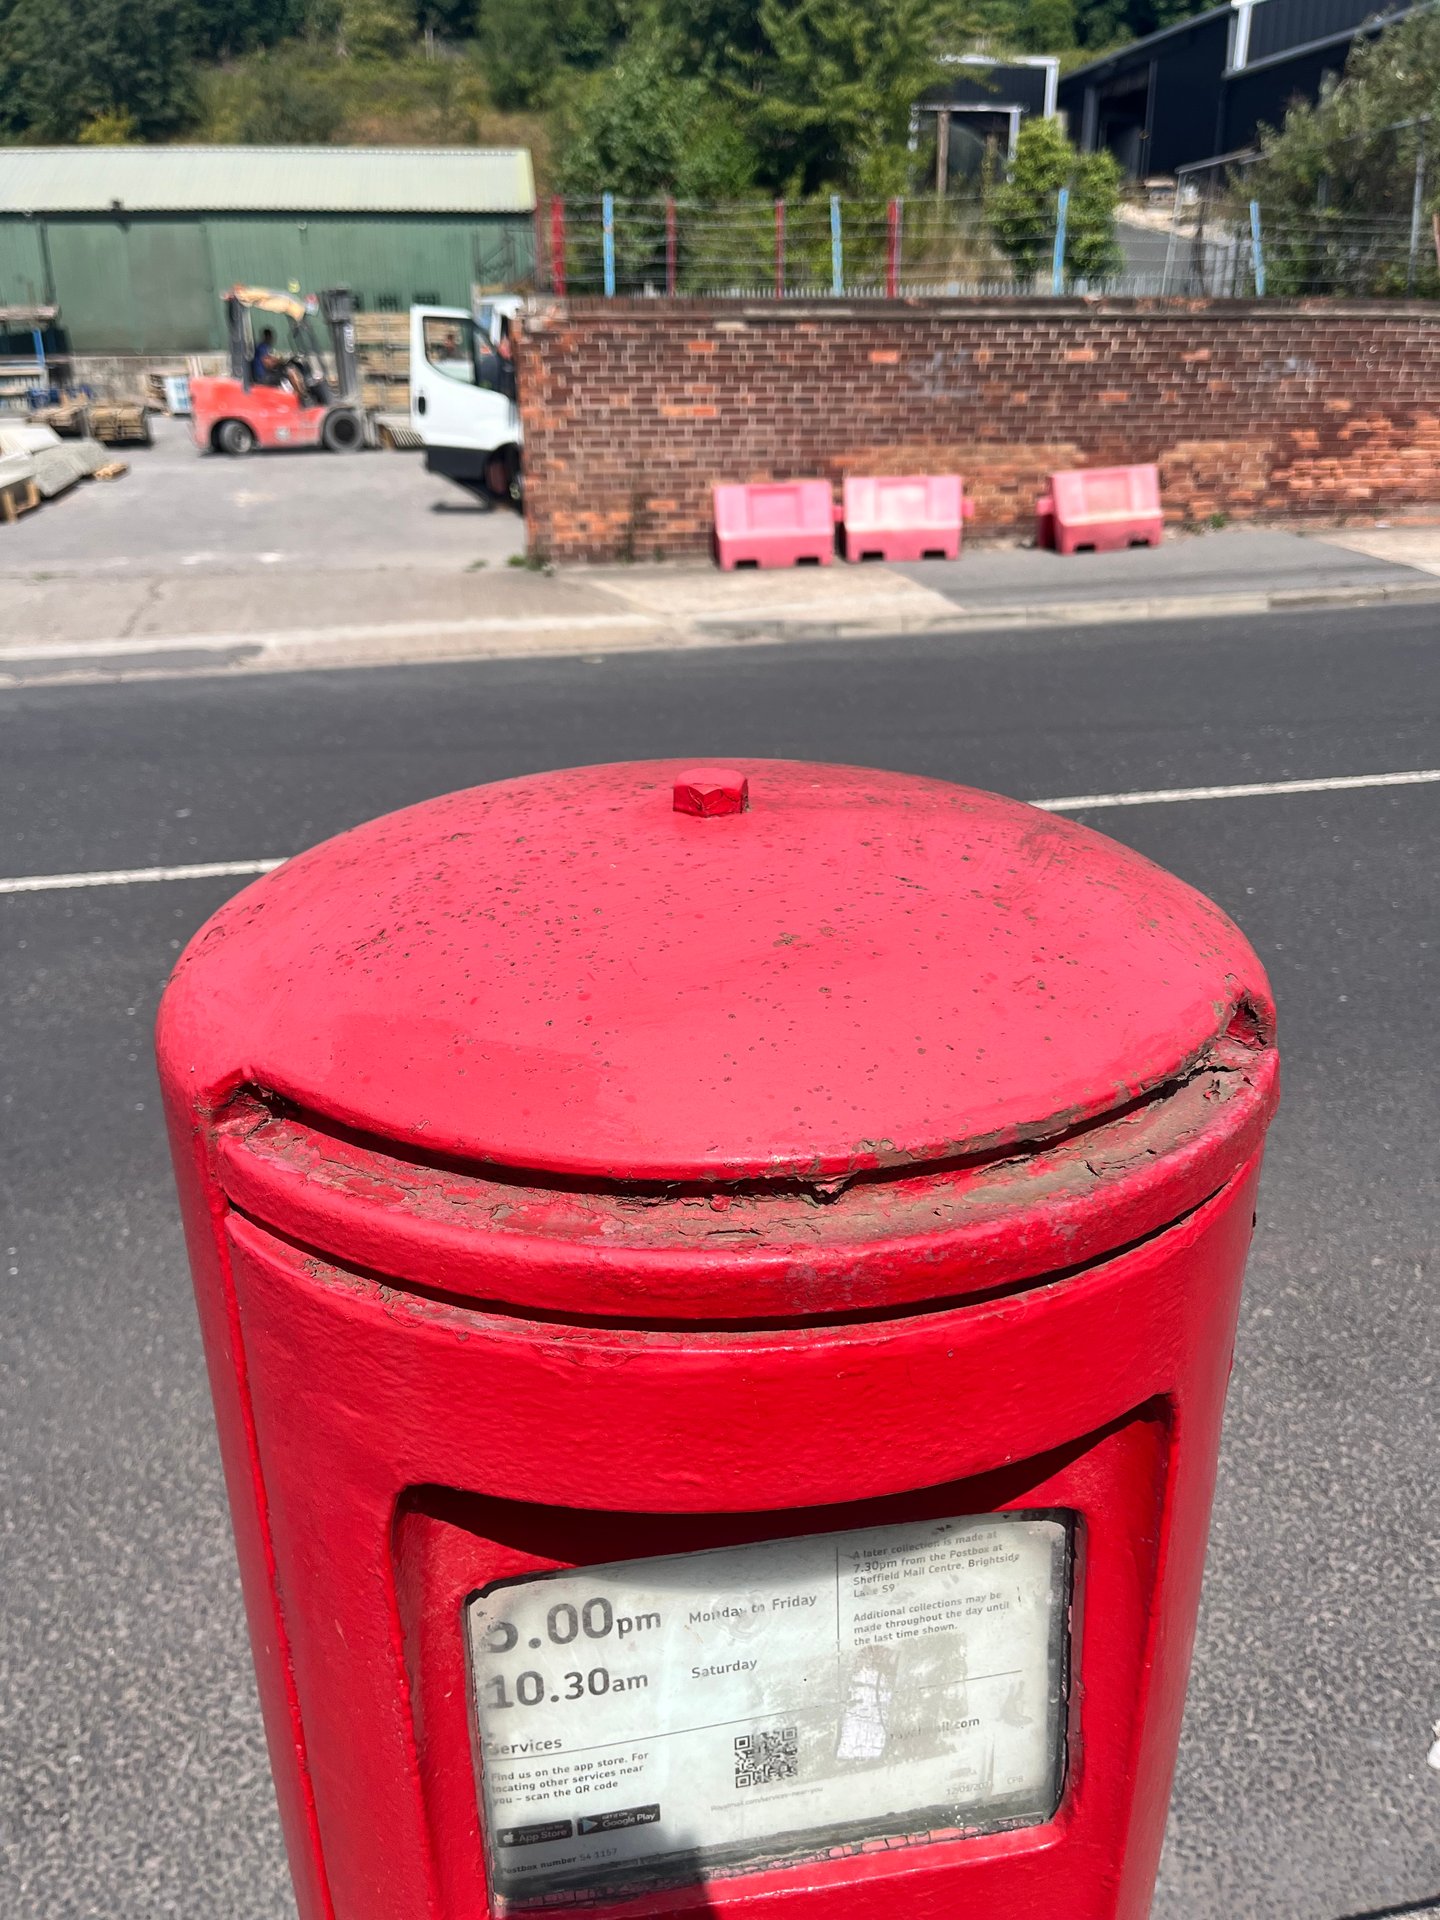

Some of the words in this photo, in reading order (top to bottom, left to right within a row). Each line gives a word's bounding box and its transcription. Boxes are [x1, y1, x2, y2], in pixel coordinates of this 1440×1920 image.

[853, 1550, 861, 1560] A
[863, 1548, 888, 1558] later
[891, 1540, 940, 1554] collection
[943, 1536, 952, 1546] is
[955, 1533, 983, 1545] made
[986, 1530, 997, 1540] at
[853, 1559, 898, 1574] 7.30pm
[901, 1555, 926, 1567] from
[929, 1551, 946, 1561] the
[950, 1546, 989, 1558] Postbox
[992, 1543, 1003, 1552] at
[853, 1571, 900, 1586] Sheffield
[903, 1566, 925, 1578] Mail
[968, 1552, 1020, 1569] Brightside
[881, 1583, 896, 1593] S9
[751, 1603, 765, 1613] to
[772, 1594, 817, 1610] Friday
[853, 1606, 906, 1622] Additional
[909, 1597, 963, 1613] collections
[965, 1594, 986, 1606] may
[989, 1591, 1002, 1601] be
[853, 1622, 883, 1635] made
[885, 1613, 943, 1629] throughout
[946, 1608, 962, 1619] the
[965, 1605, 984, 1617] day
[986, 1601, 1010, 1613] until
[853, 1636, 871, 1646] the
[874, 1632, 894, 1643] last
[896, 1629, 919, 1640] time
[922, 1622, 958, 1636] shown.
[691, 1658, 758, 1679] Saturday
[485, 1667, 649, 1709] 10.30am
[491, 1772, 515, 1782] Find
[518, 1771, 531, 1780] us
[535, 1769, 549, 1778] on
[552, 1765, 570, 1775] the
[573, 1762, 594, 1773] app
[597, 1756, 628, 1768] store.
[631, 1751, 649, 1762] For
[492, 1781, 536, 1794] locating
[539, 1777, 569, 1789] other
[572, 1769, 616, 1783] services
[619, 1765, 644, 1776] near
[492, 1796, 513, 1807] you
[525, 1792, 550, 1802] scan
[553, 1788, 571, 1798] the
[575, 1784, 590, 1795] QR
[594, 1780, 619, 1791] code
[602, 1817, 635, 1828] Google
[636, 1812, 656, 1822] Play
[519, 1833, 539, 1843] App
[541, 1829, 568, 1839] Store
[540, 1856, 576, 1869] number
